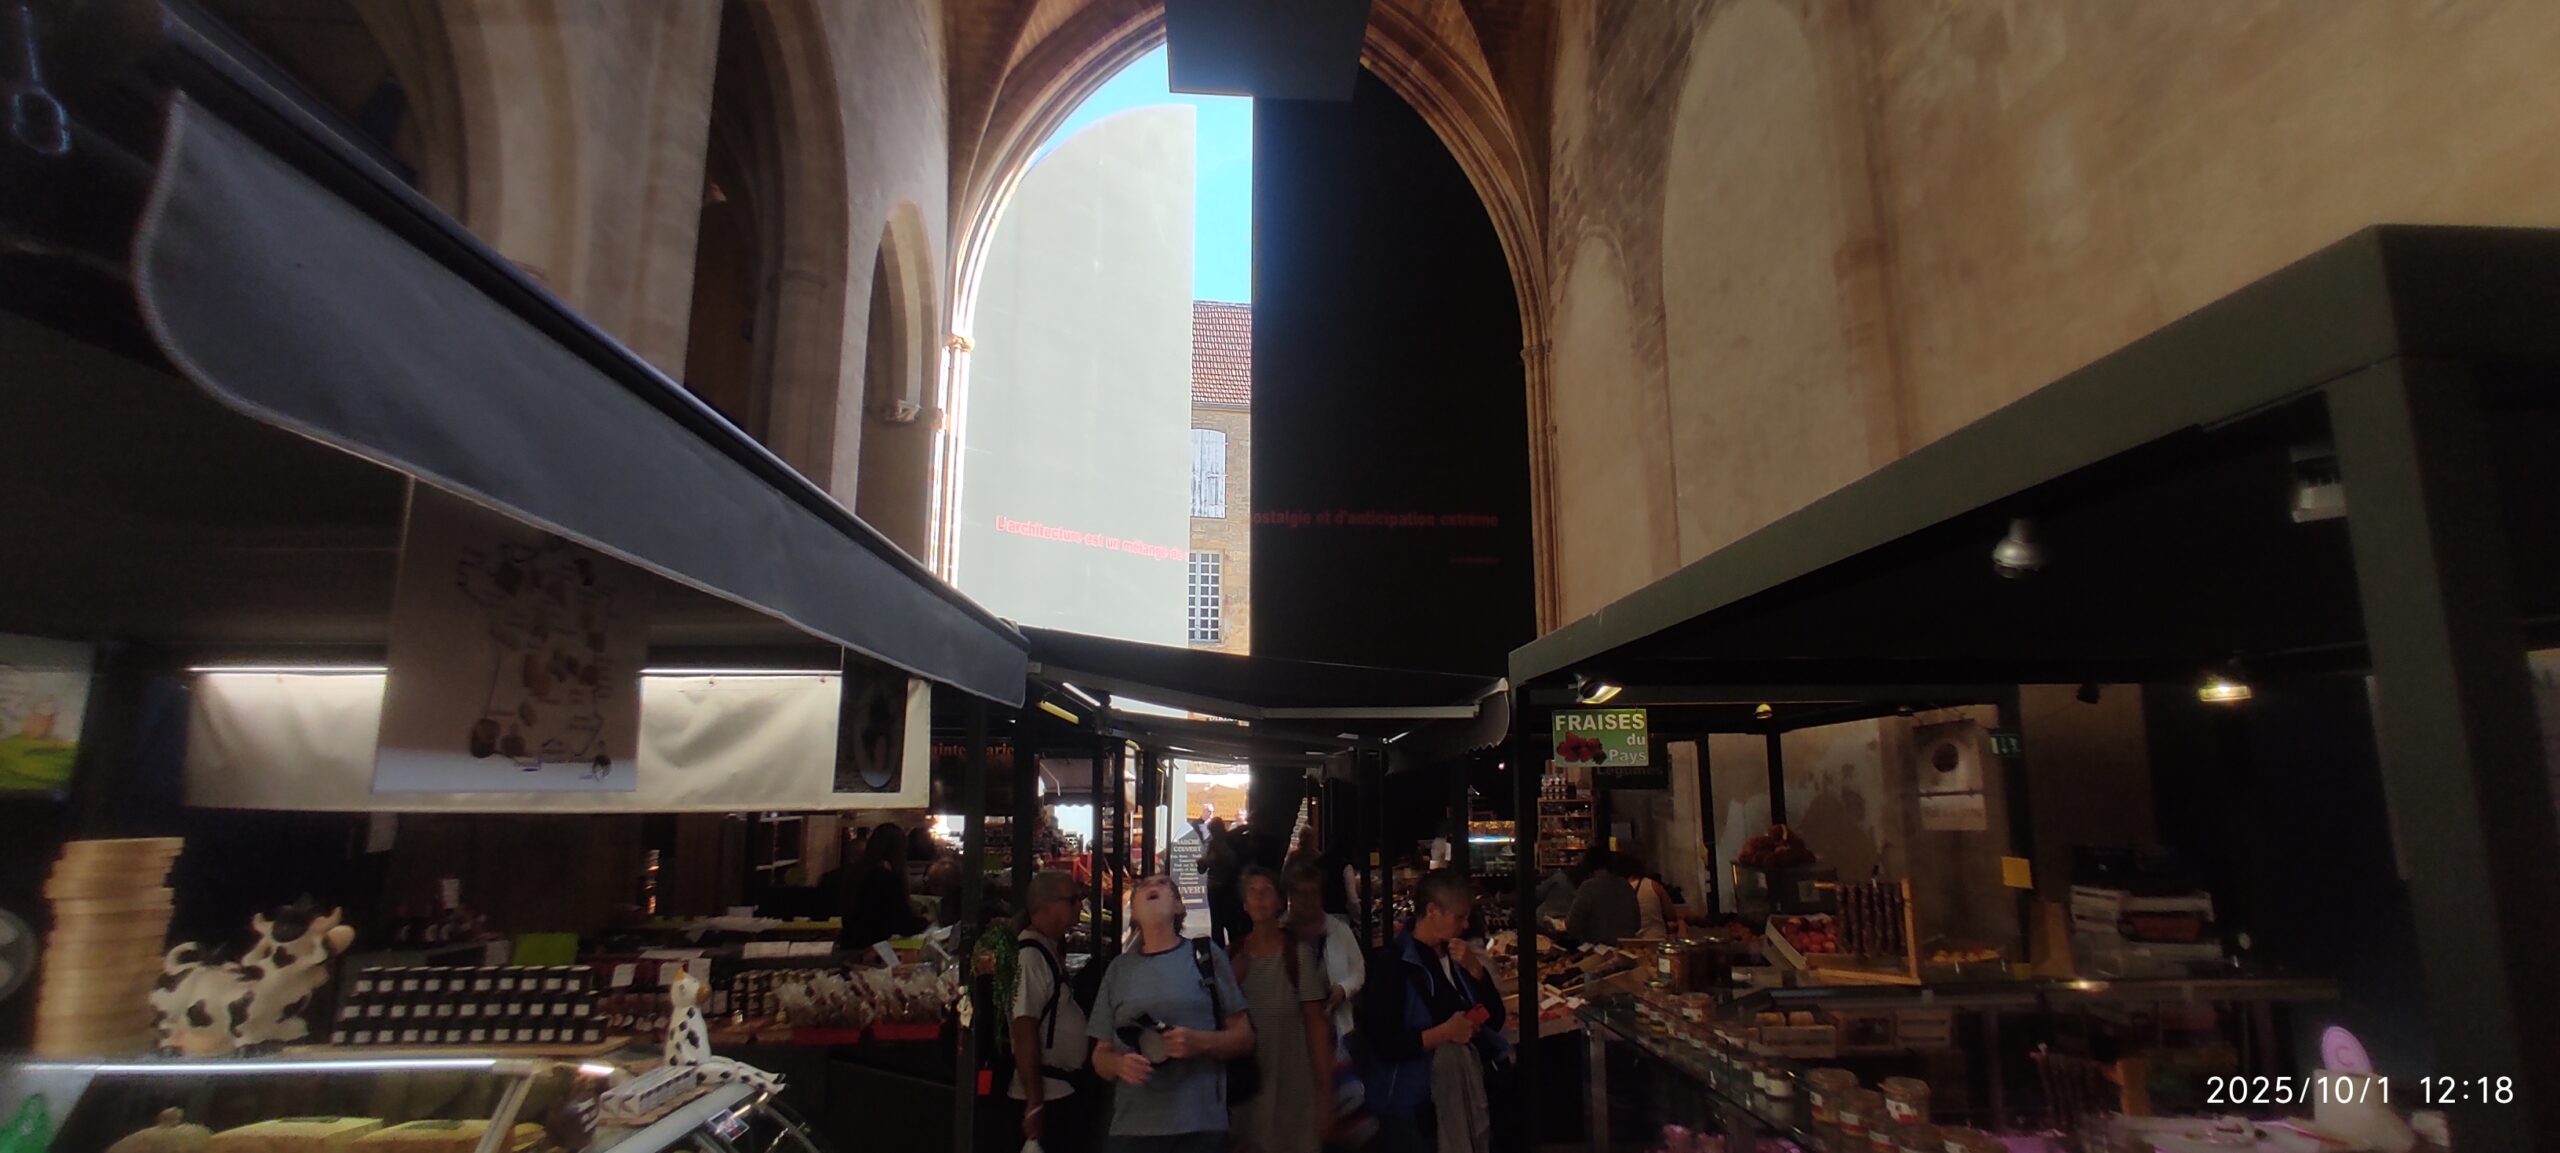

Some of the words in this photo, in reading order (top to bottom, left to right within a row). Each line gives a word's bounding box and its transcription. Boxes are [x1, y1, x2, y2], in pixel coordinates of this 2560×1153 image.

[1316, 511, 1331, 526] et
[1335, 510, 1435, 528] d'anticipation
[995, 515, 1082, 544] L'architecture
[1084, 533, 1104, 548] est
[1106, 536, 1121, 550] un
[1555, 713, 1645, 731] FRAISES
[1626, 733, 1646, 746] du
[986, 742, 1015, 756] arie
[1609, 749, 1646, 764] Pays
